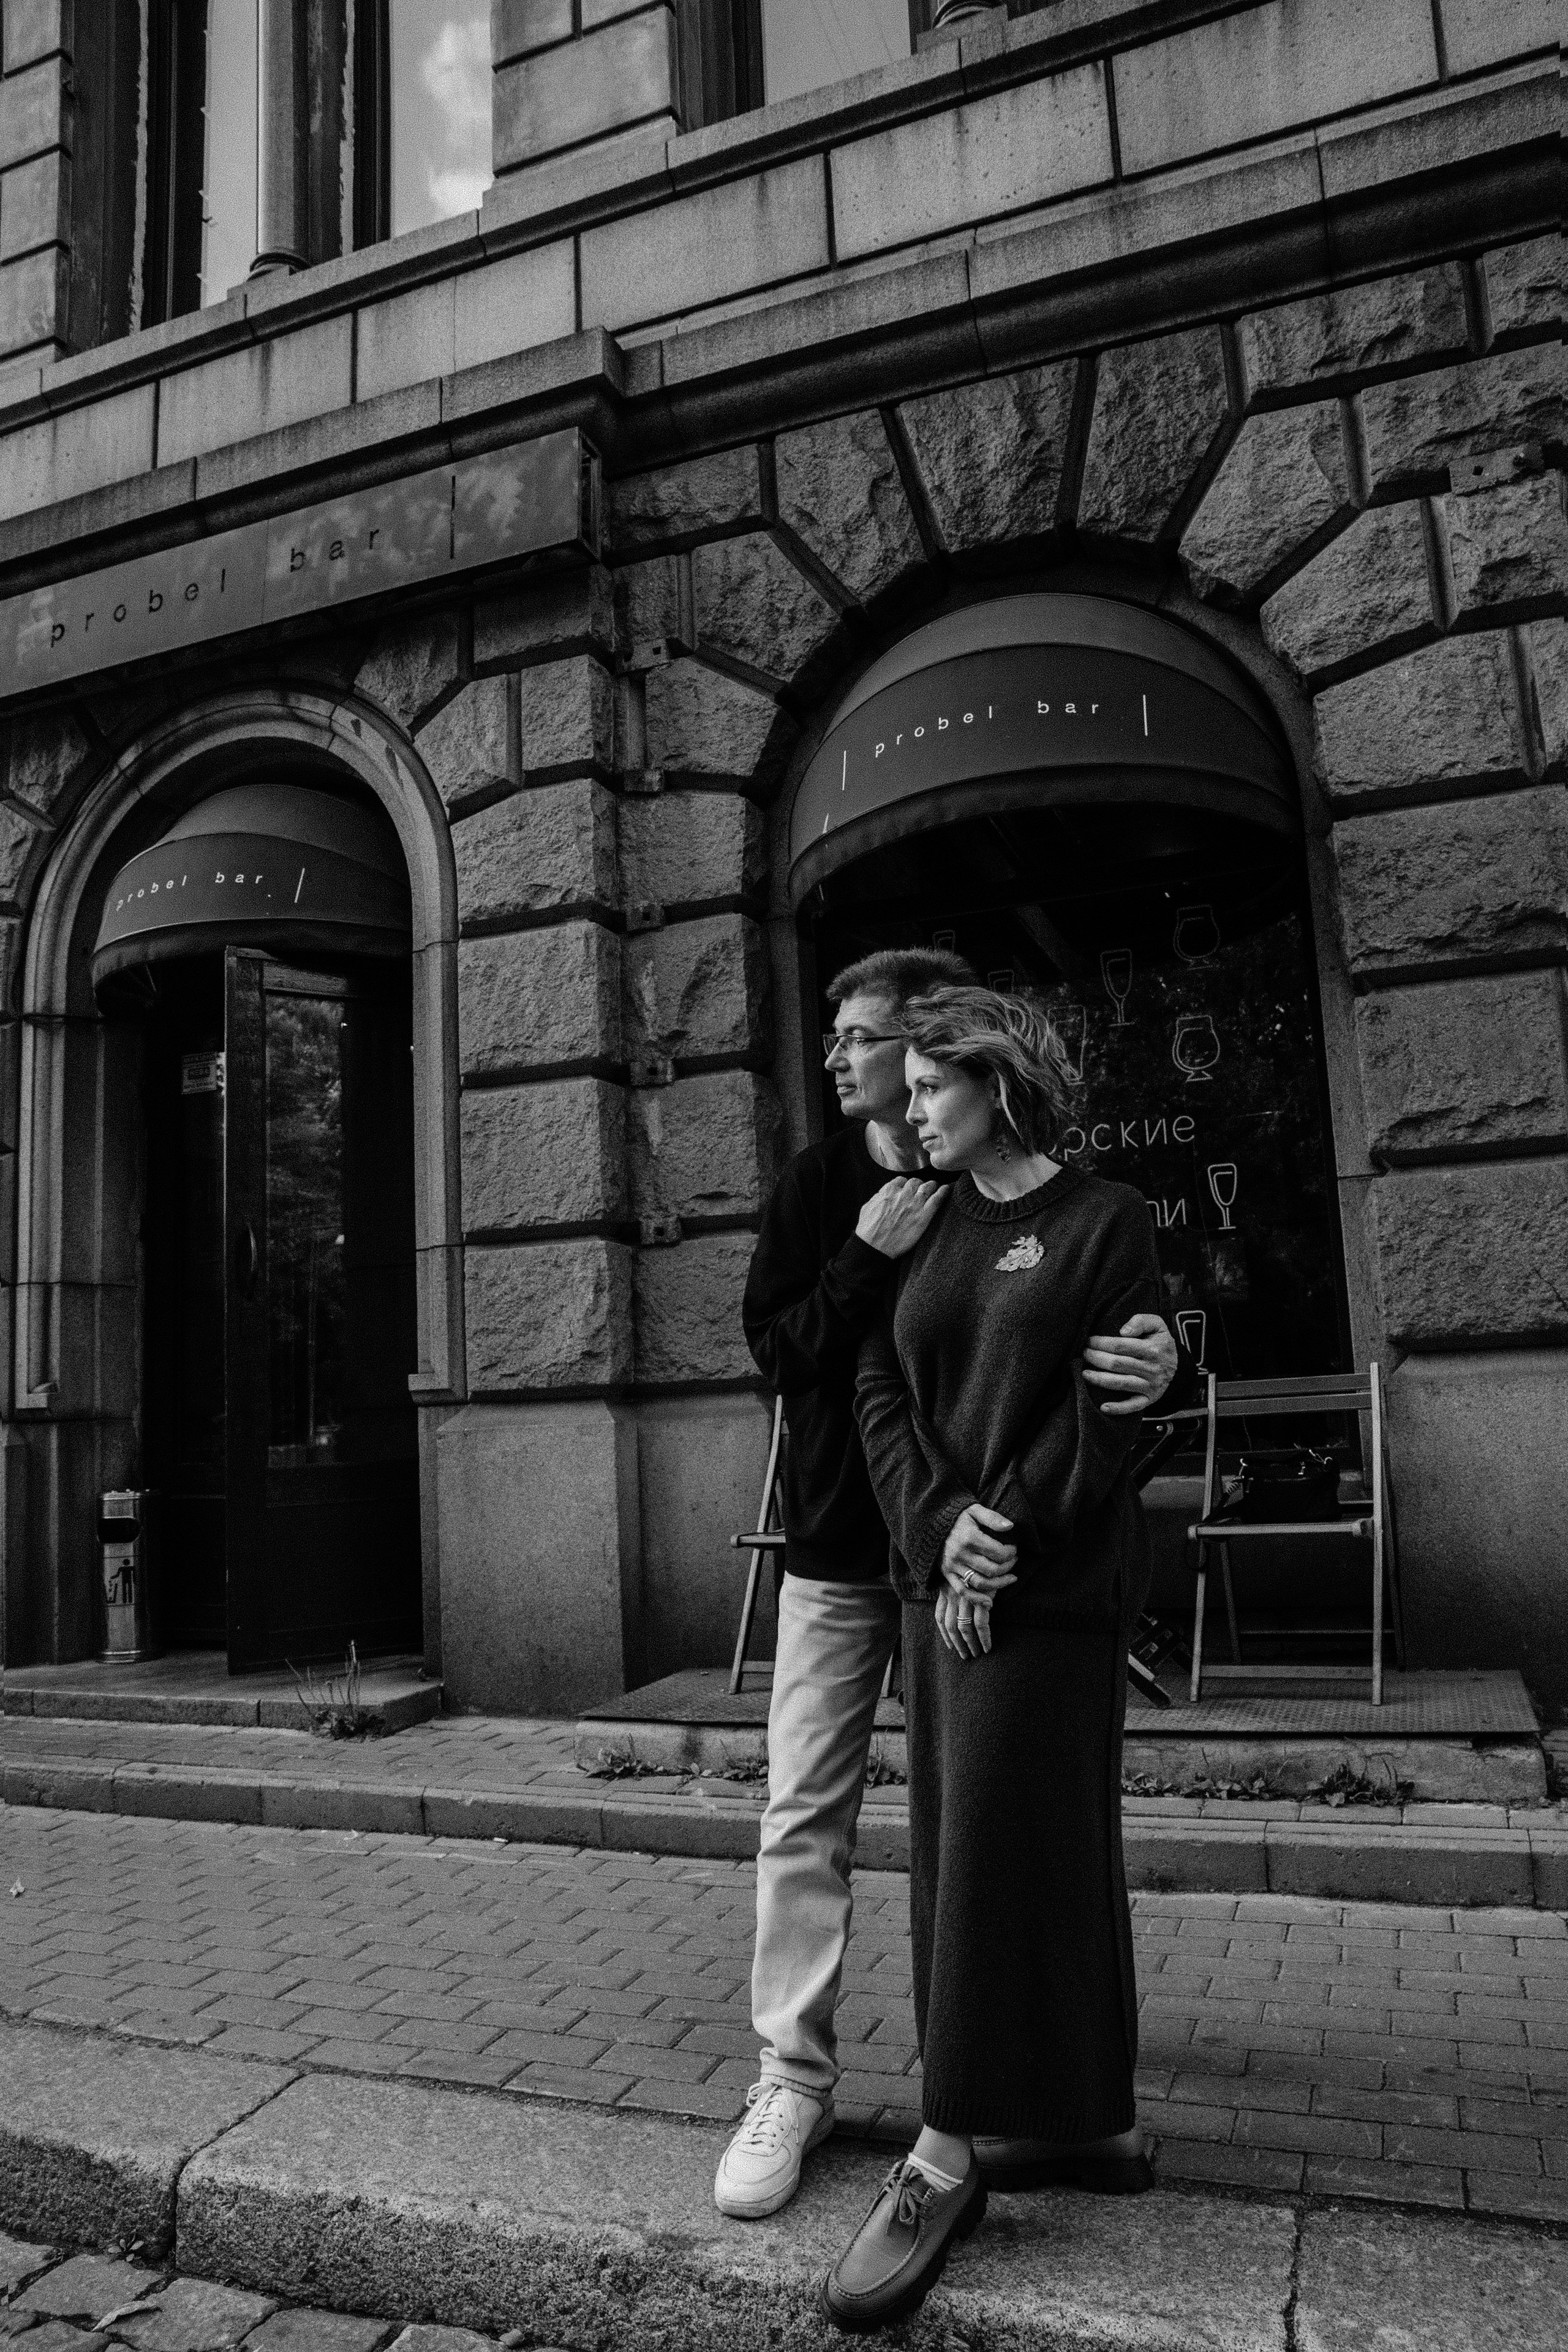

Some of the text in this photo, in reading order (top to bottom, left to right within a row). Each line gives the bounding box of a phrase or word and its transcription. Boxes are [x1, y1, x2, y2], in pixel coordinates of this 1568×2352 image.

[50, 528, 380, 649] probel bar
[875, 700, 1099, 758] probel bar
[115, 871, 263, 911] probel bar
[1049, 1115, 1196, 1162] рские
